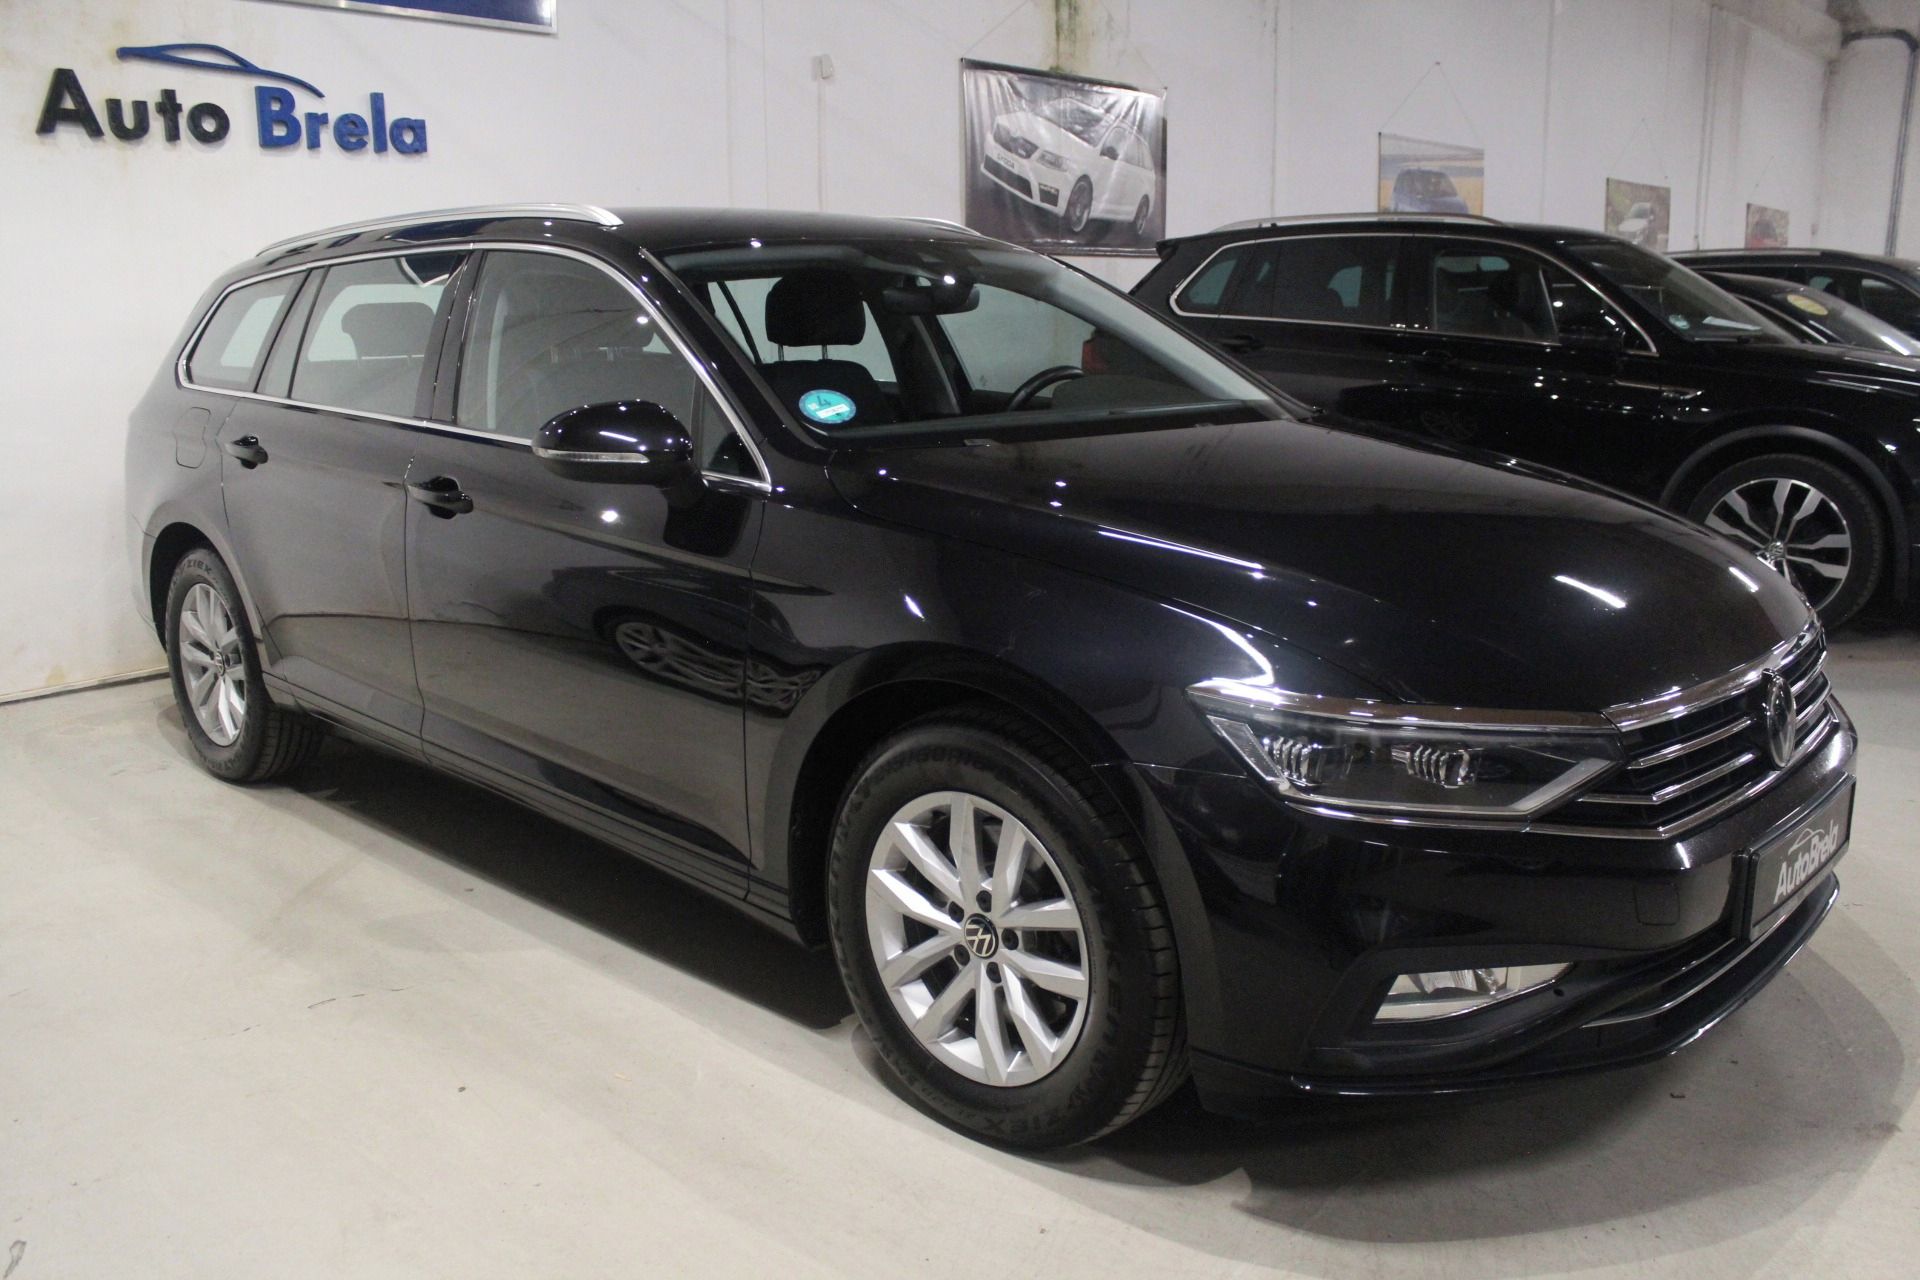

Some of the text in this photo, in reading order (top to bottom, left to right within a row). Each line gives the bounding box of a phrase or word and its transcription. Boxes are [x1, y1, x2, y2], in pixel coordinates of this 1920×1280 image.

[36, 68, 428, 154] Auto Brela
[1774, 819, 1839, 904] AutoBrela
